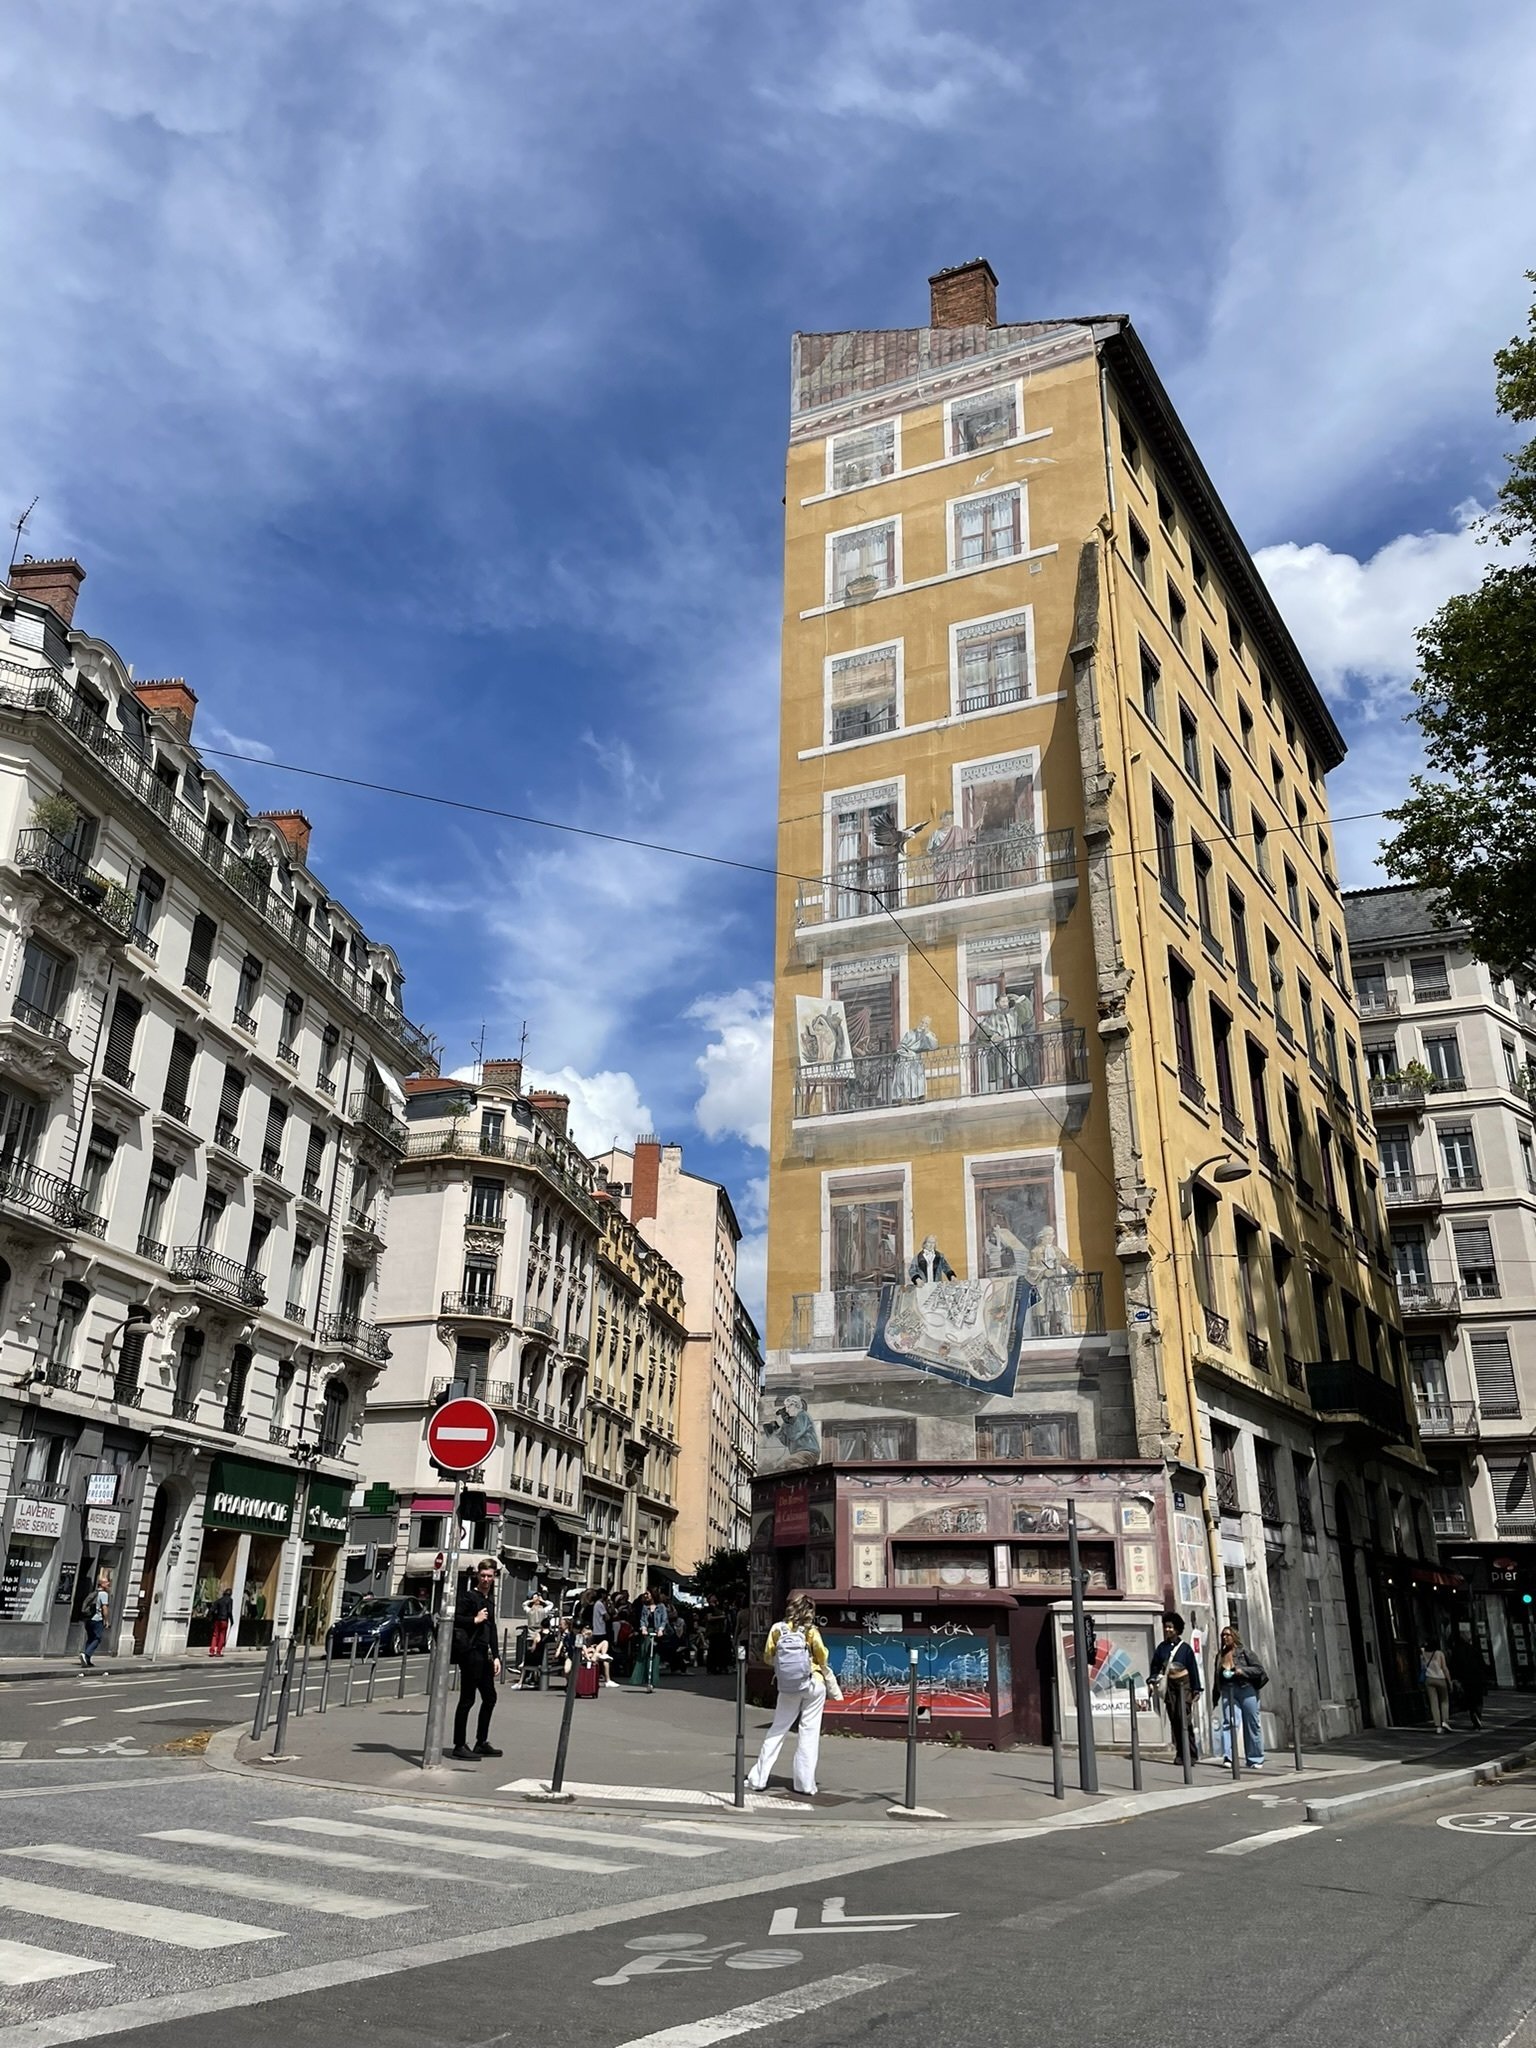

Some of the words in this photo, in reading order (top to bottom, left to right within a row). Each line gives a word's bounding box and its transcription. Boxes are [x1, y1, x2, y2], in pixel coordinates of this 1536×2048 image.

[20, 1503, 56, 1520] LAVERIE
[213, 1492, 289, 1522] PHARMACIE
[16, 1517, 31, 1531] IBRE
[31, 1519, 59, 1534] SERVICE
[89, 1513, 108, 1525] AVERIE
[108, 1515, 116, 1526] DE
[91, 1527, 116, 1540] FRESQUE
[1491, 1571, 1518, 1584] pier
[1091, 1702, 1131, 1711] HROMATIC
